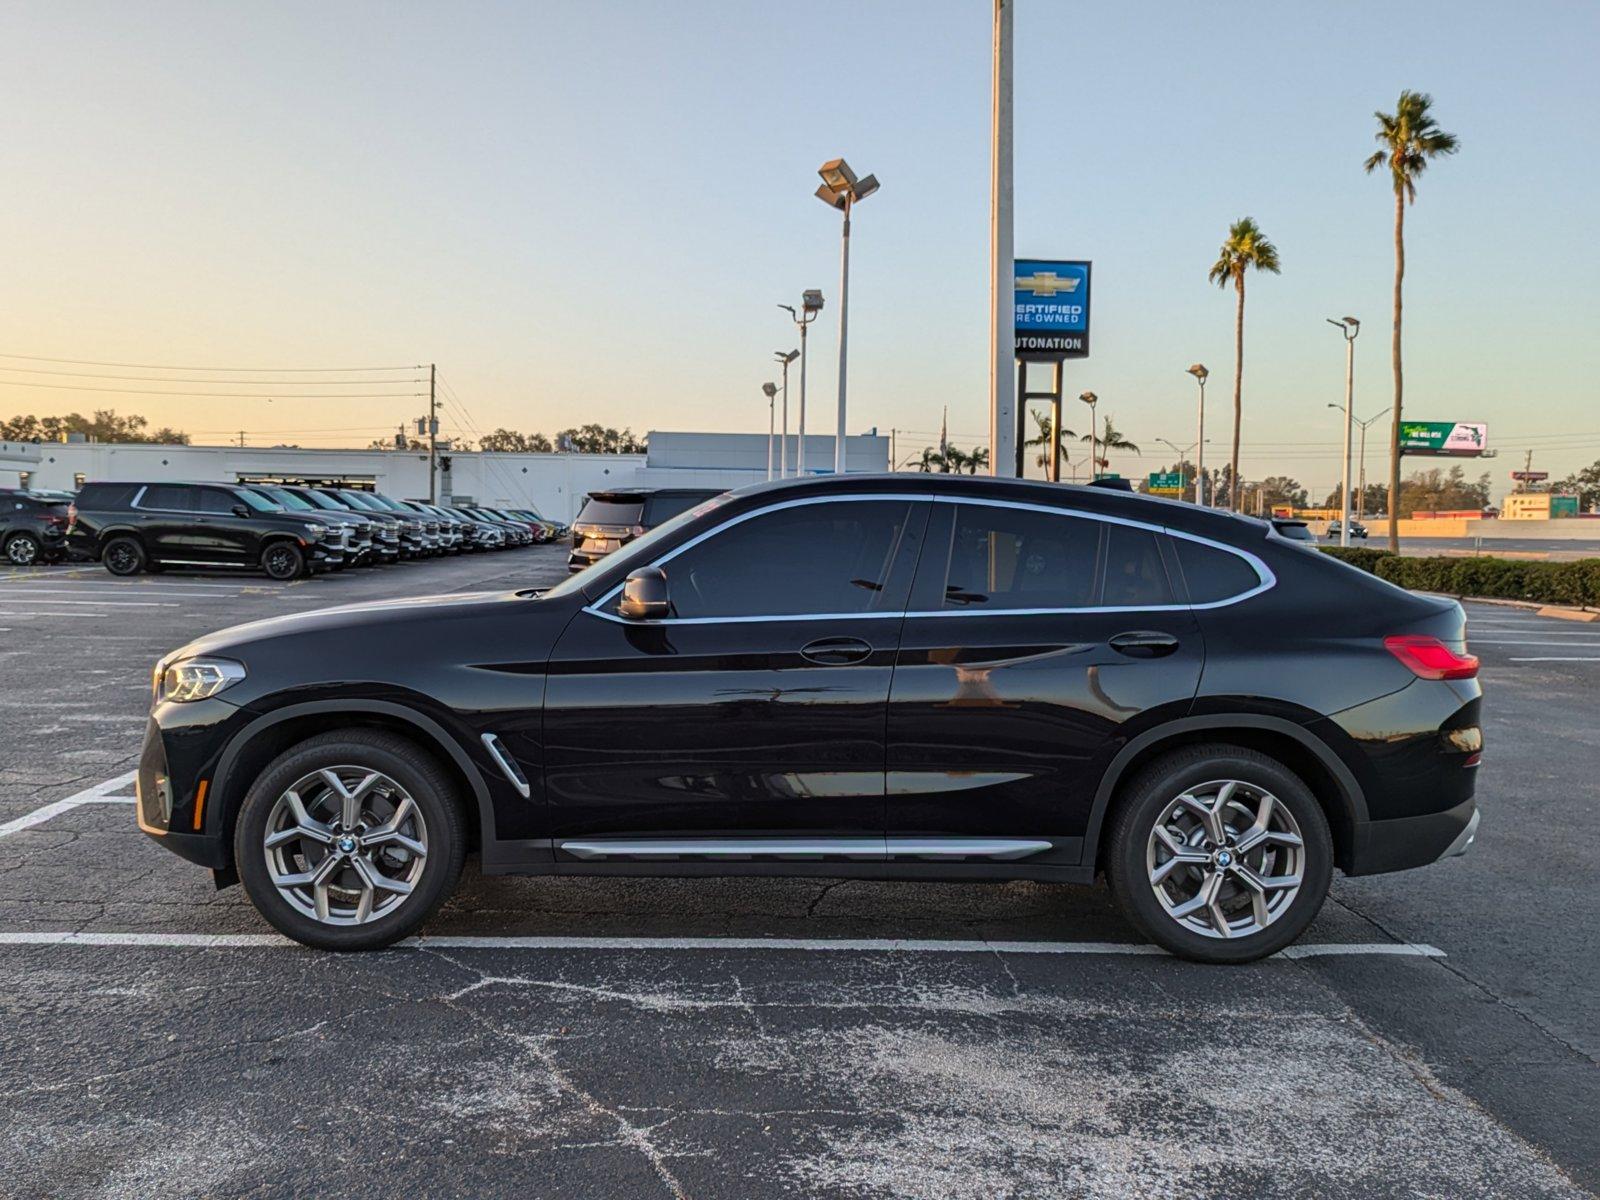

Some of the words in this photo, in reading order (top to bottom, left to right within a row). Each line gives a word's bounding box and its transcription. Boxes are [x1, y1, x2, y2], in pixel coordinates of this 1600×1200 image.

[1016, 304, 1082, 315] ERTIFIED
[1016, 314, 1079, 323] RE-OWNED
[1015, 337, 1082, 349] UTONATION
